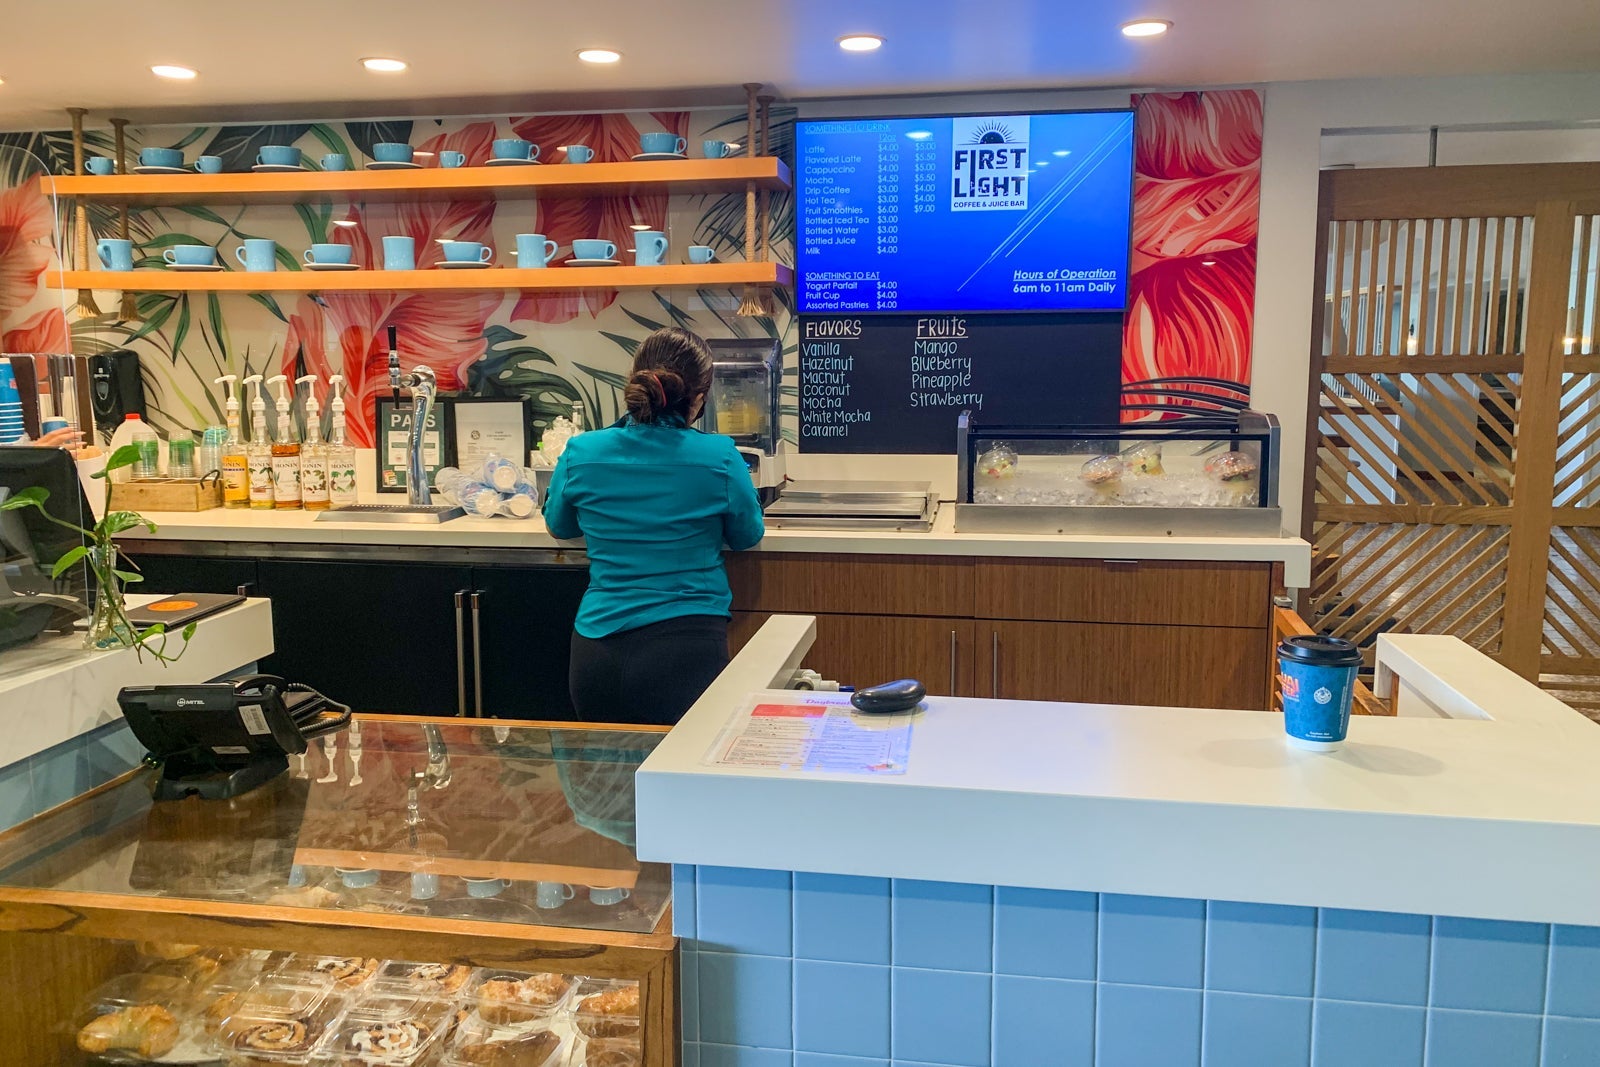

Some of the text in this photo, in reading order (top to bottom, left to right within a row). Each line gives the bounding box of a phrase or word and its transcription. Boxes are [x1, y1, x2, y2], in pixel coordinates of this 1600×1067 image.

[805, 124, 851, 134] SOMETHING
[878, 143, 899, 152] $4.00
[915, 142, 936, 151] $5.00
[805, 152, 936, 164] Flavored Latte $4.50 $5.50
[955, 148, 1027, 170] FIRST
[805, 163, 936, 175] Cappuccino $4.00 $5.00
[878, 174, 899, 183] $4.50
[914, 173, 936, 182] $5.50
[805, 184, 936, 195] Drip Coffee $3.00 $4.00
[954, 176, 1026, 197] LIGHT
[821, 196, 836, 204] Tea
[878, 195, 899, 204] $3.00
[914, 194, 936, 203] $4.00
[823, 206, 863, 214] Smoothies
[877, 205, 898, 213] $6.00
[914, 204, 935, 213] $9.00
[805, 217, 833, 225] Bottled
[855, 216, 870, 224] Tea
[877, 215, 898, 224] $3.00
[805, 227, 833, 235] Bottled
[877, 226, 898, 234] $3.00
[805, 237, 833, 245] Bottled
[877, 236, 898, 244] $4.00
[877, 246, 898, 254] $4.00
[805, 271, 880, 280] SOMETHING TO EAT
[1013, 269, 1116, 280] Hours of Operation
[805, 283, 831, 291] Yogurt
[1013, 282, 1116, 293] 6am to 11am Daily
[823, 292, 840, 300] Cup
[877, 291, 898, 299] $4.00
[877, 301, 898, 309] $4.00
[802, 341, 840, 357] Vanilla
[914, 340, 958, 357] Mango
[802, 355, 854, 371] Hazelnut
[911, 355, 972, 374] Blueberry
[803, 371, 846, 385] Macnut
[912, 371, 972, 392] Pineapple
[803, 383, 851, 397] Coconut
[803, 396, 842, 409] Mocha
[910, 391, 983, 411] Strawberry
[391, 414, 436, 428] PAS
[802, 408, 871, 423] White Mocha
[802, 424, 849, 437] Caramel
